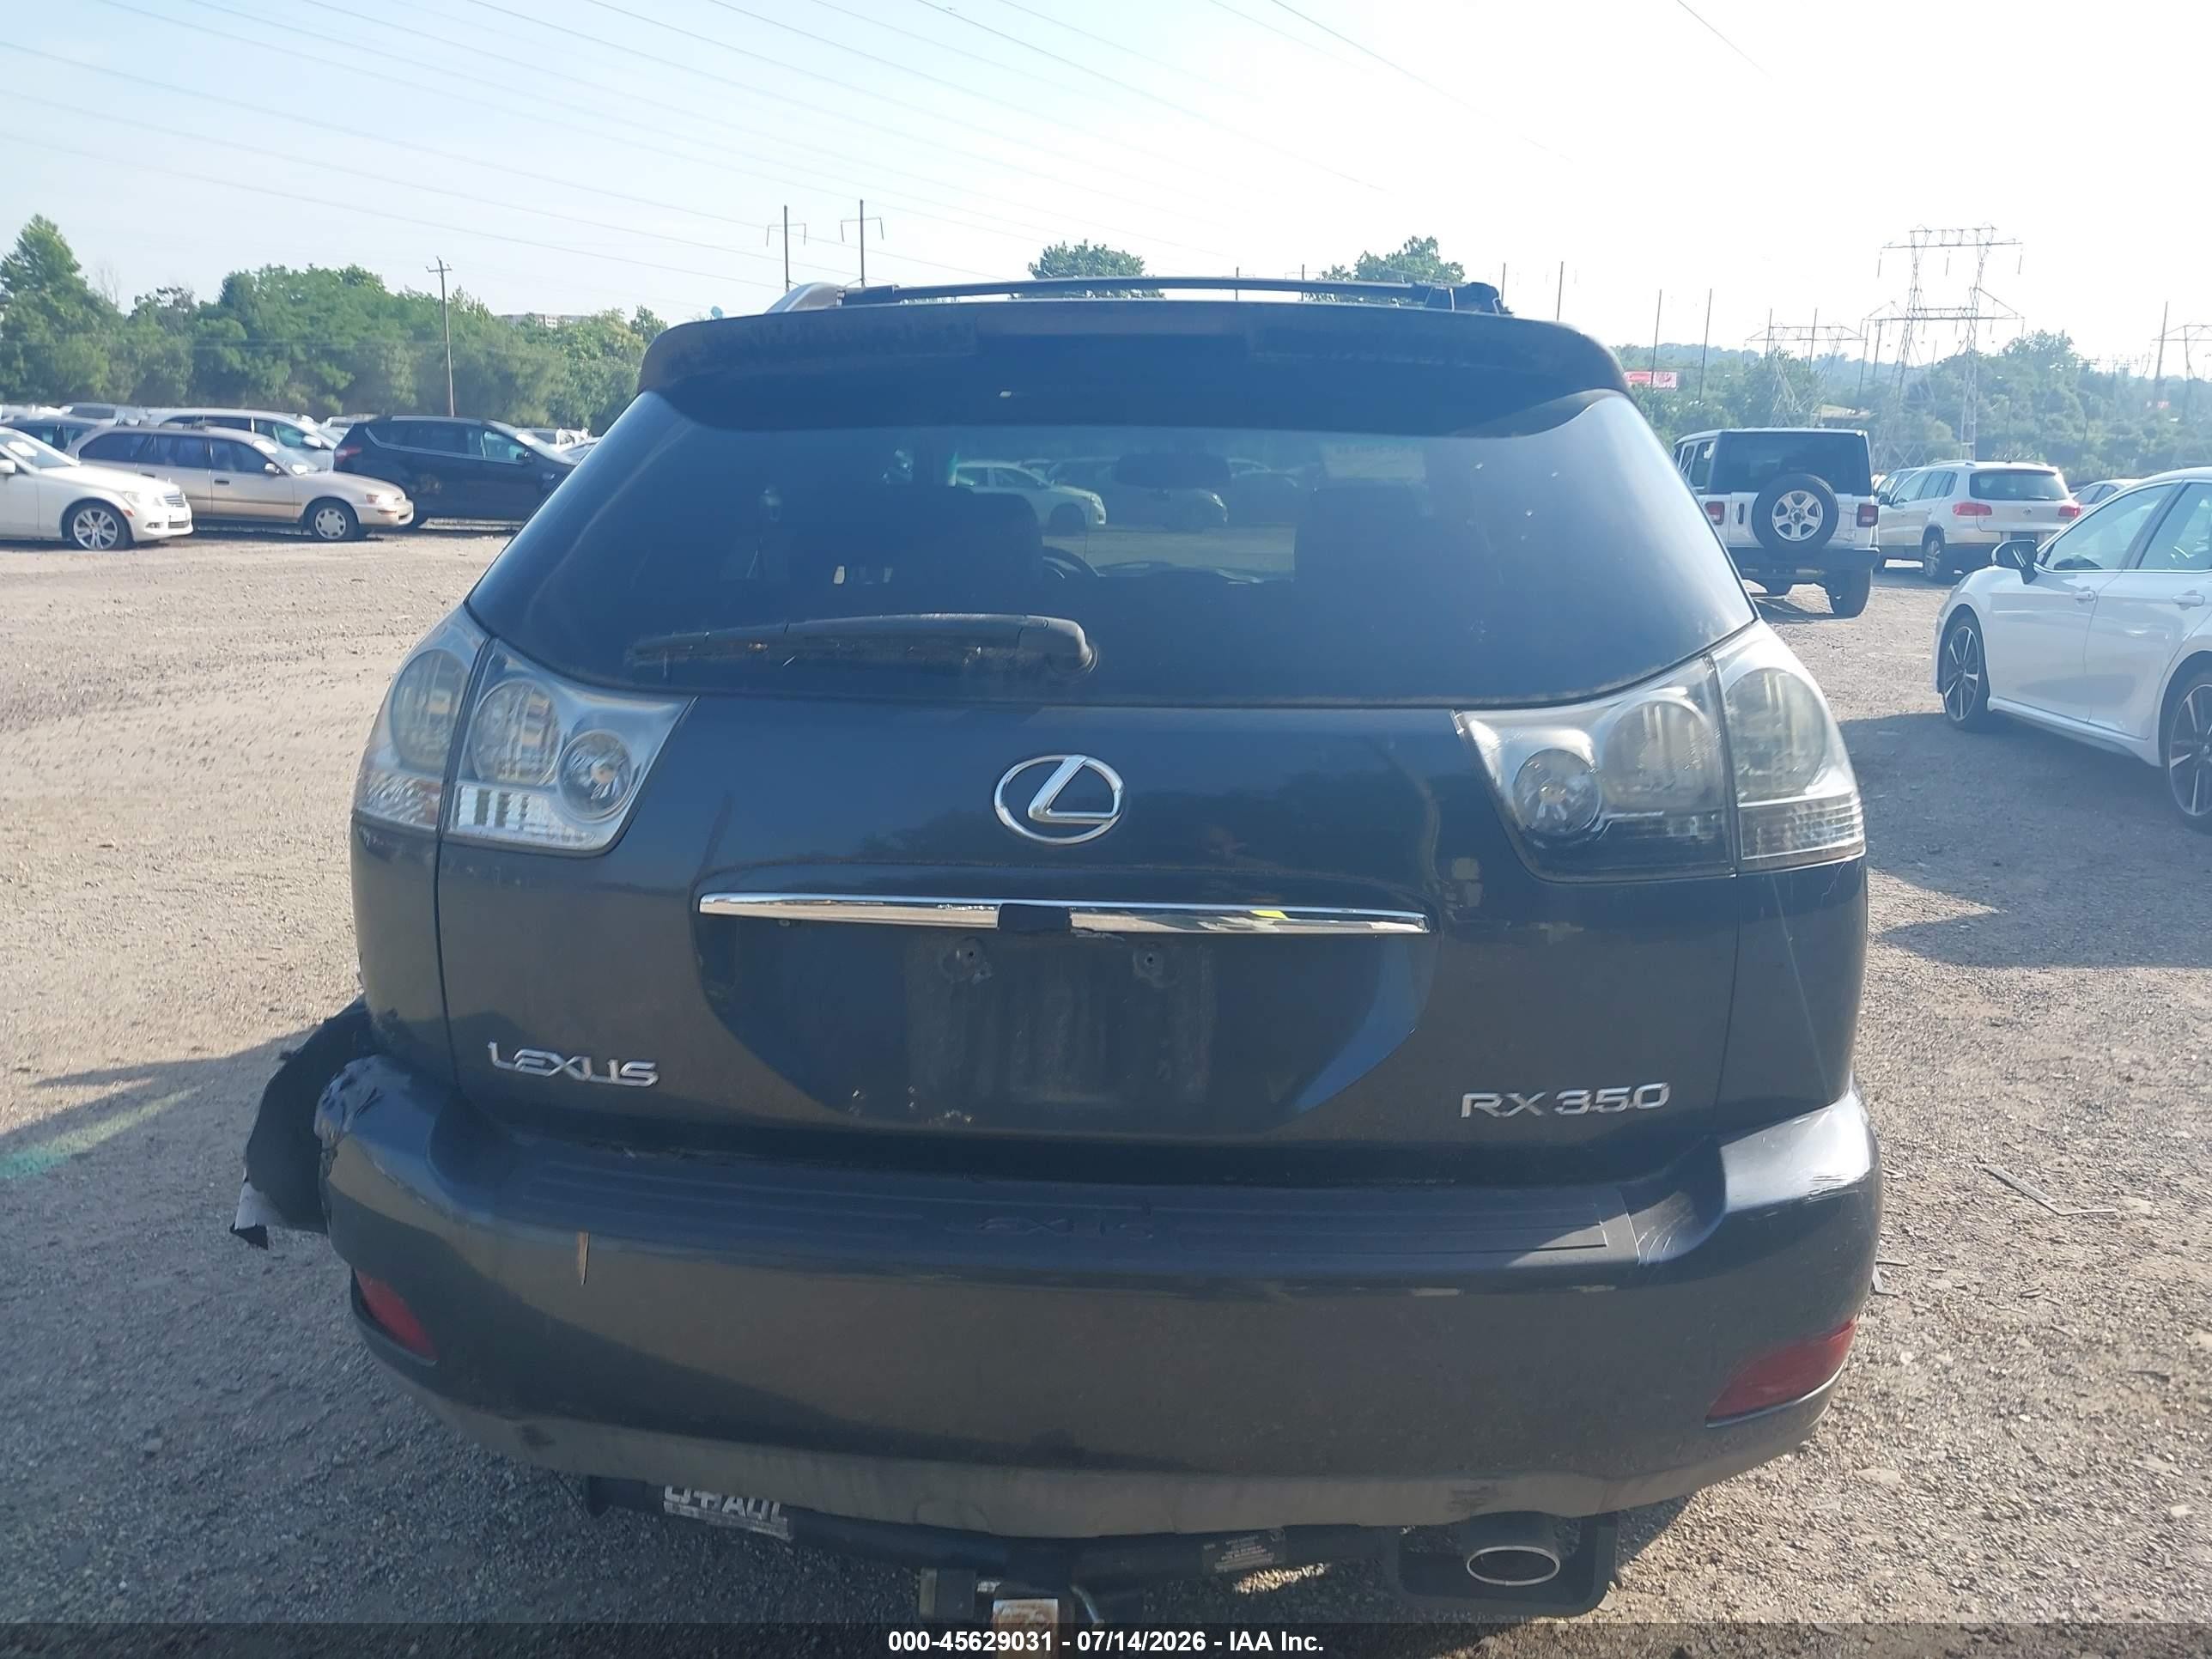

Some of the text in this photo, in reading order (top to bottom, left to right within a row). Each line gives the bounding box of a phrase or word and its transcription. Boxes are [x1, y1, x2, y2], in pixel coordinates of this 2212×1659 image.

[487, 1042, 659, 1087] LEXUS
[1461, 1082, 1671, 1118] RX 350
